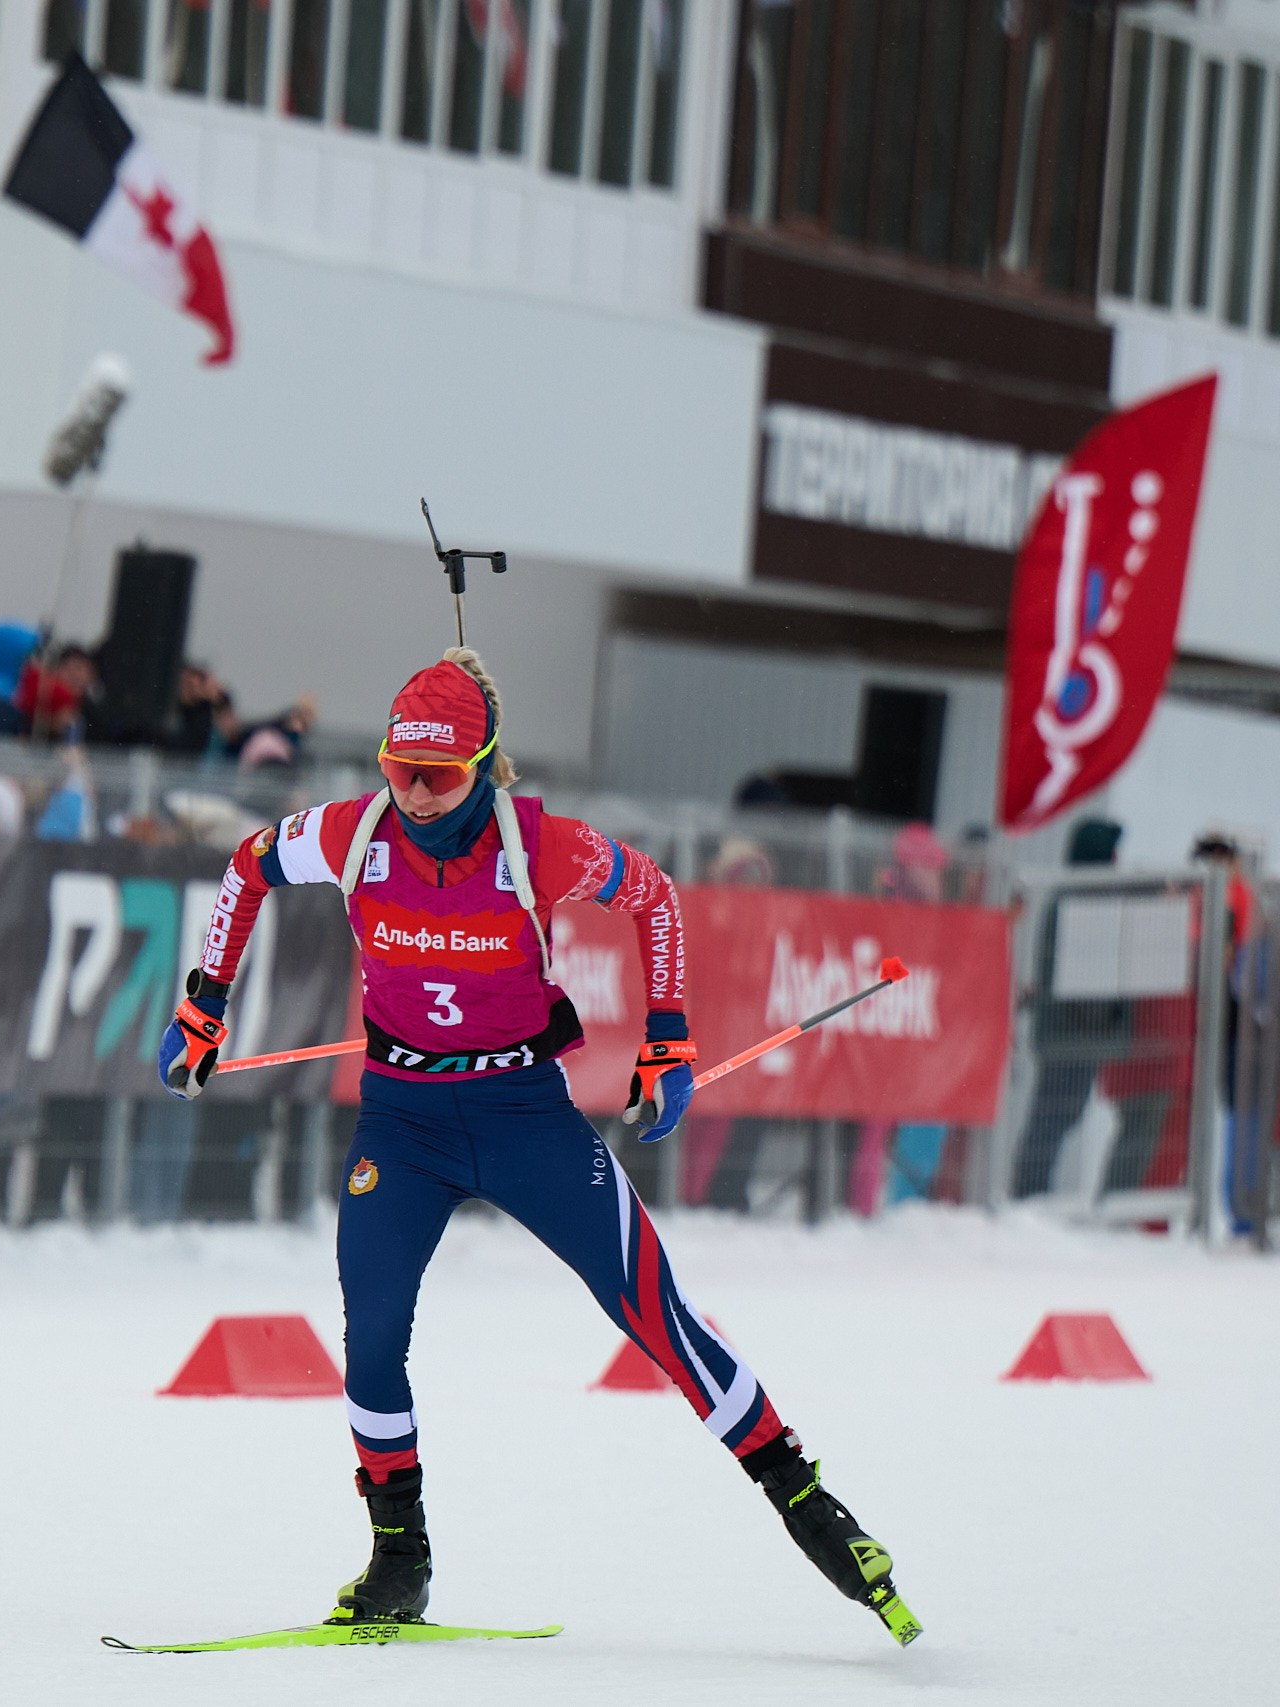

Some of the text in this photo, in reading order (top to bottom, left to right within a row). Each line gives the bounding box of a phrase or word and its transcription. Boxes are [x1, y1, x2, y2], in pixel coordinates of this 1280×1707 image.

[393, 721, 453, 735] МОСОБЛ
[392, 731, 439, 743] СПОРТ
[373, 921, 510, 953] Альфа Банк
[422, 981, 464, 1027] 3
[350, 1625, 400, 1640] FISCHER
